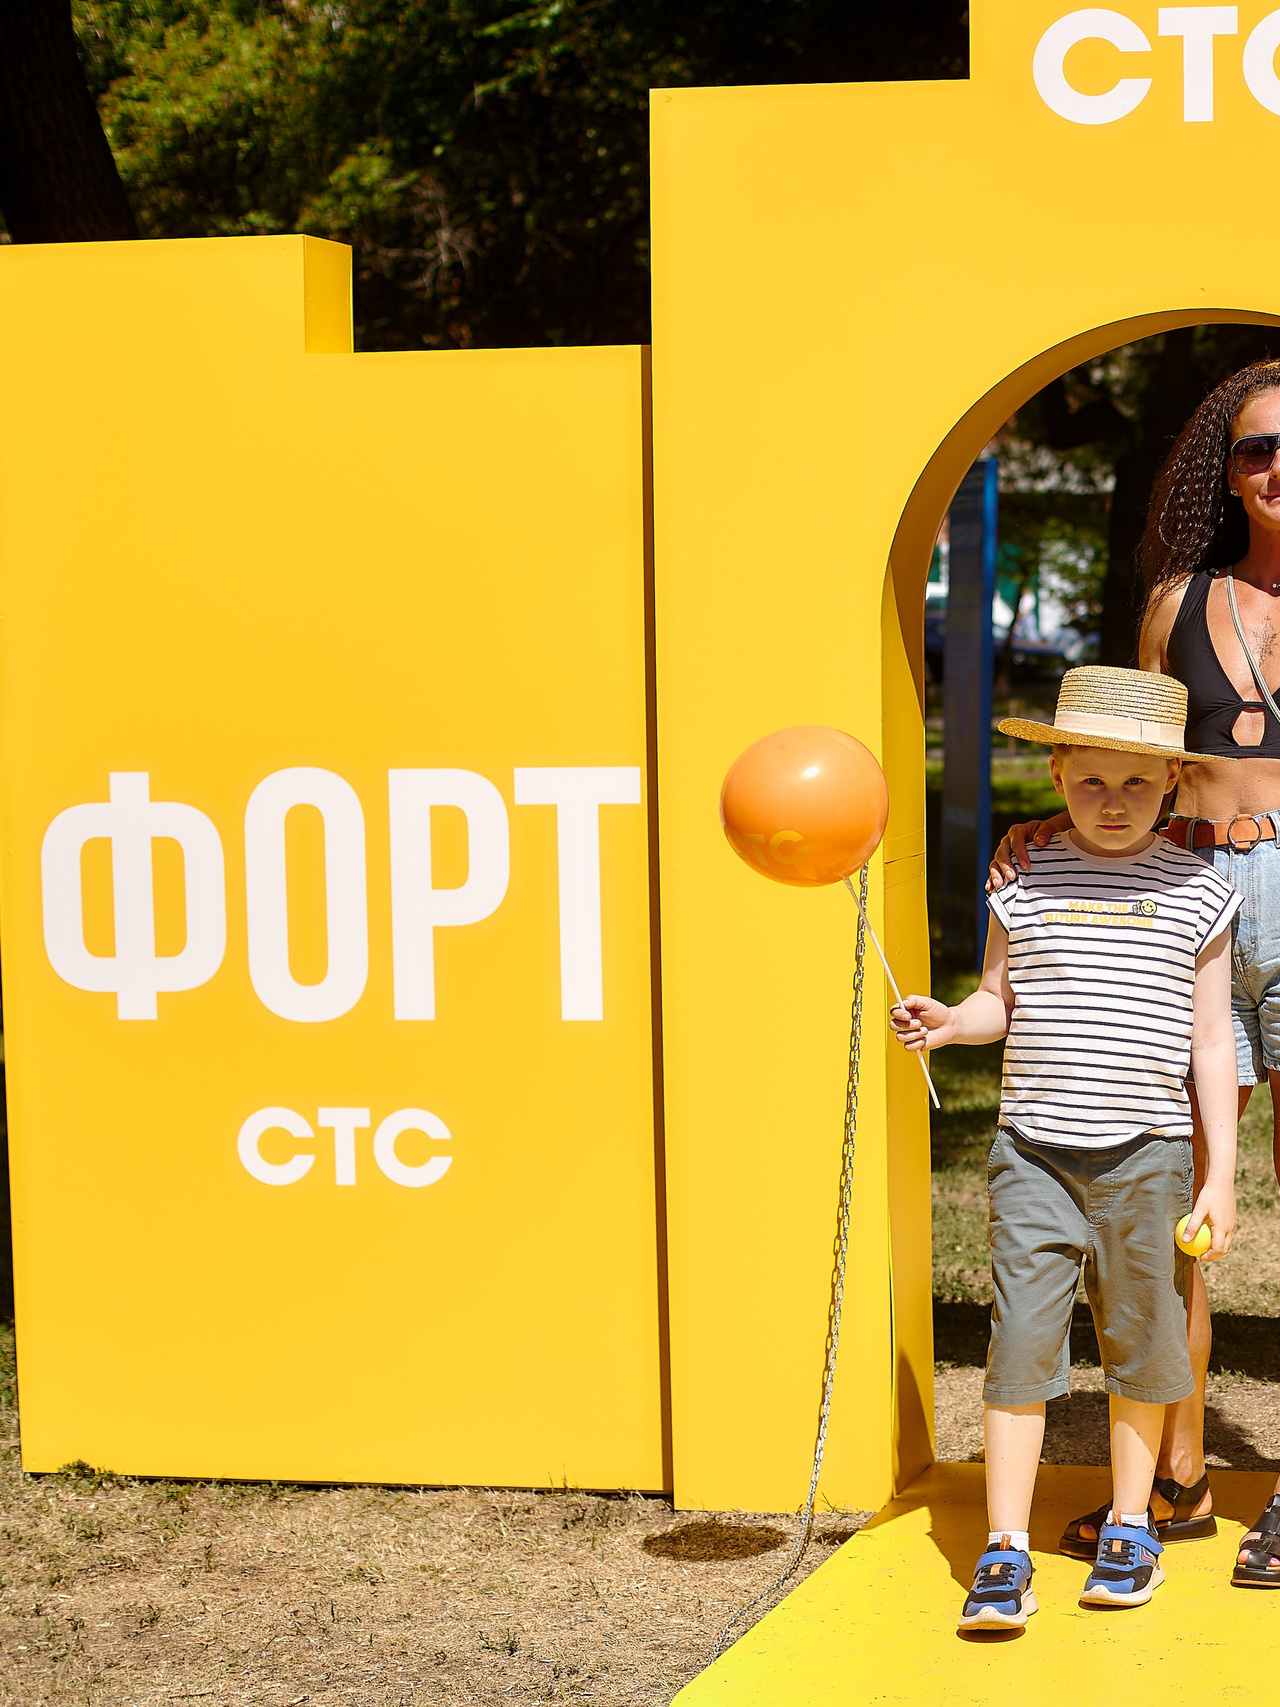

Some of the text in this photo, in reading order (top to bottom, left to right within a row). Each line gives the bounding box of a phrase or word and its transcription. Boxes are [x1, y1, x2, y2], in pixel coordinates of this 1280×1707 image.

[40, 766, 641, 1023] ФОРТ
[1068, 901, 1128, 913] MAKE THE
[1044, 913, 1154, 928] FUTURE AWESOME
[237, 1106, 453, 1188] СТС
